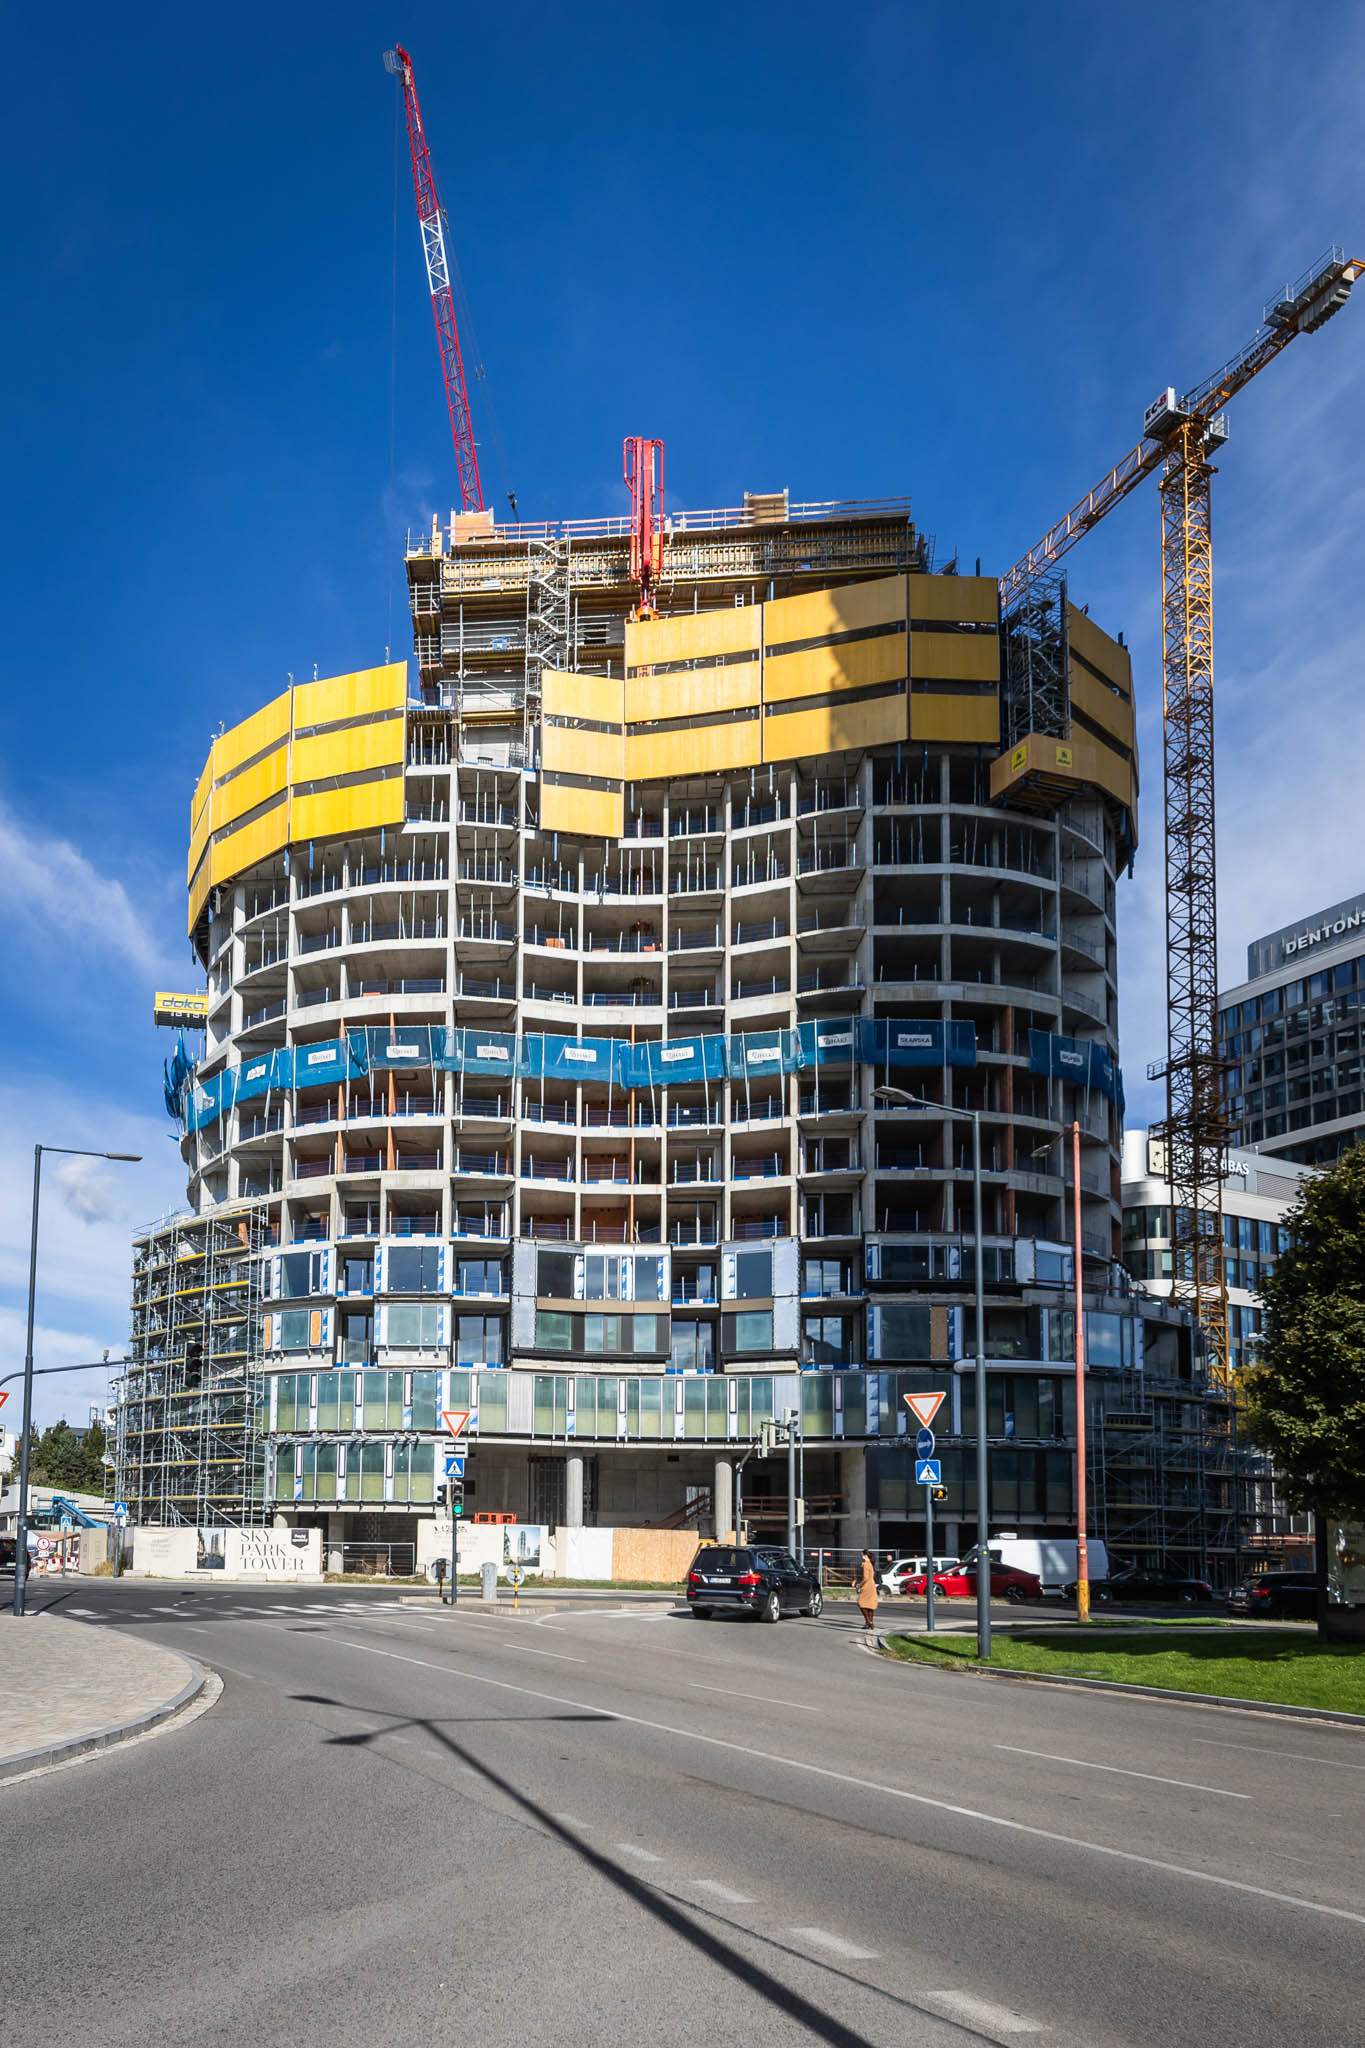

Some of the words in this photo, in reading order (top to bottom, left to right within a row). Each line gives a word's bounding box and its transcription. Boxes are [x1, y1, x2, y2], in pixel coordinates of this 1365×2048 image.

[162, 997, 204, 1009] doka
[240, 1530, 272, 1542] SKY
[241, 1544, 286, 1556] PARK
[240, 1557, 304, 1570] TOWER
